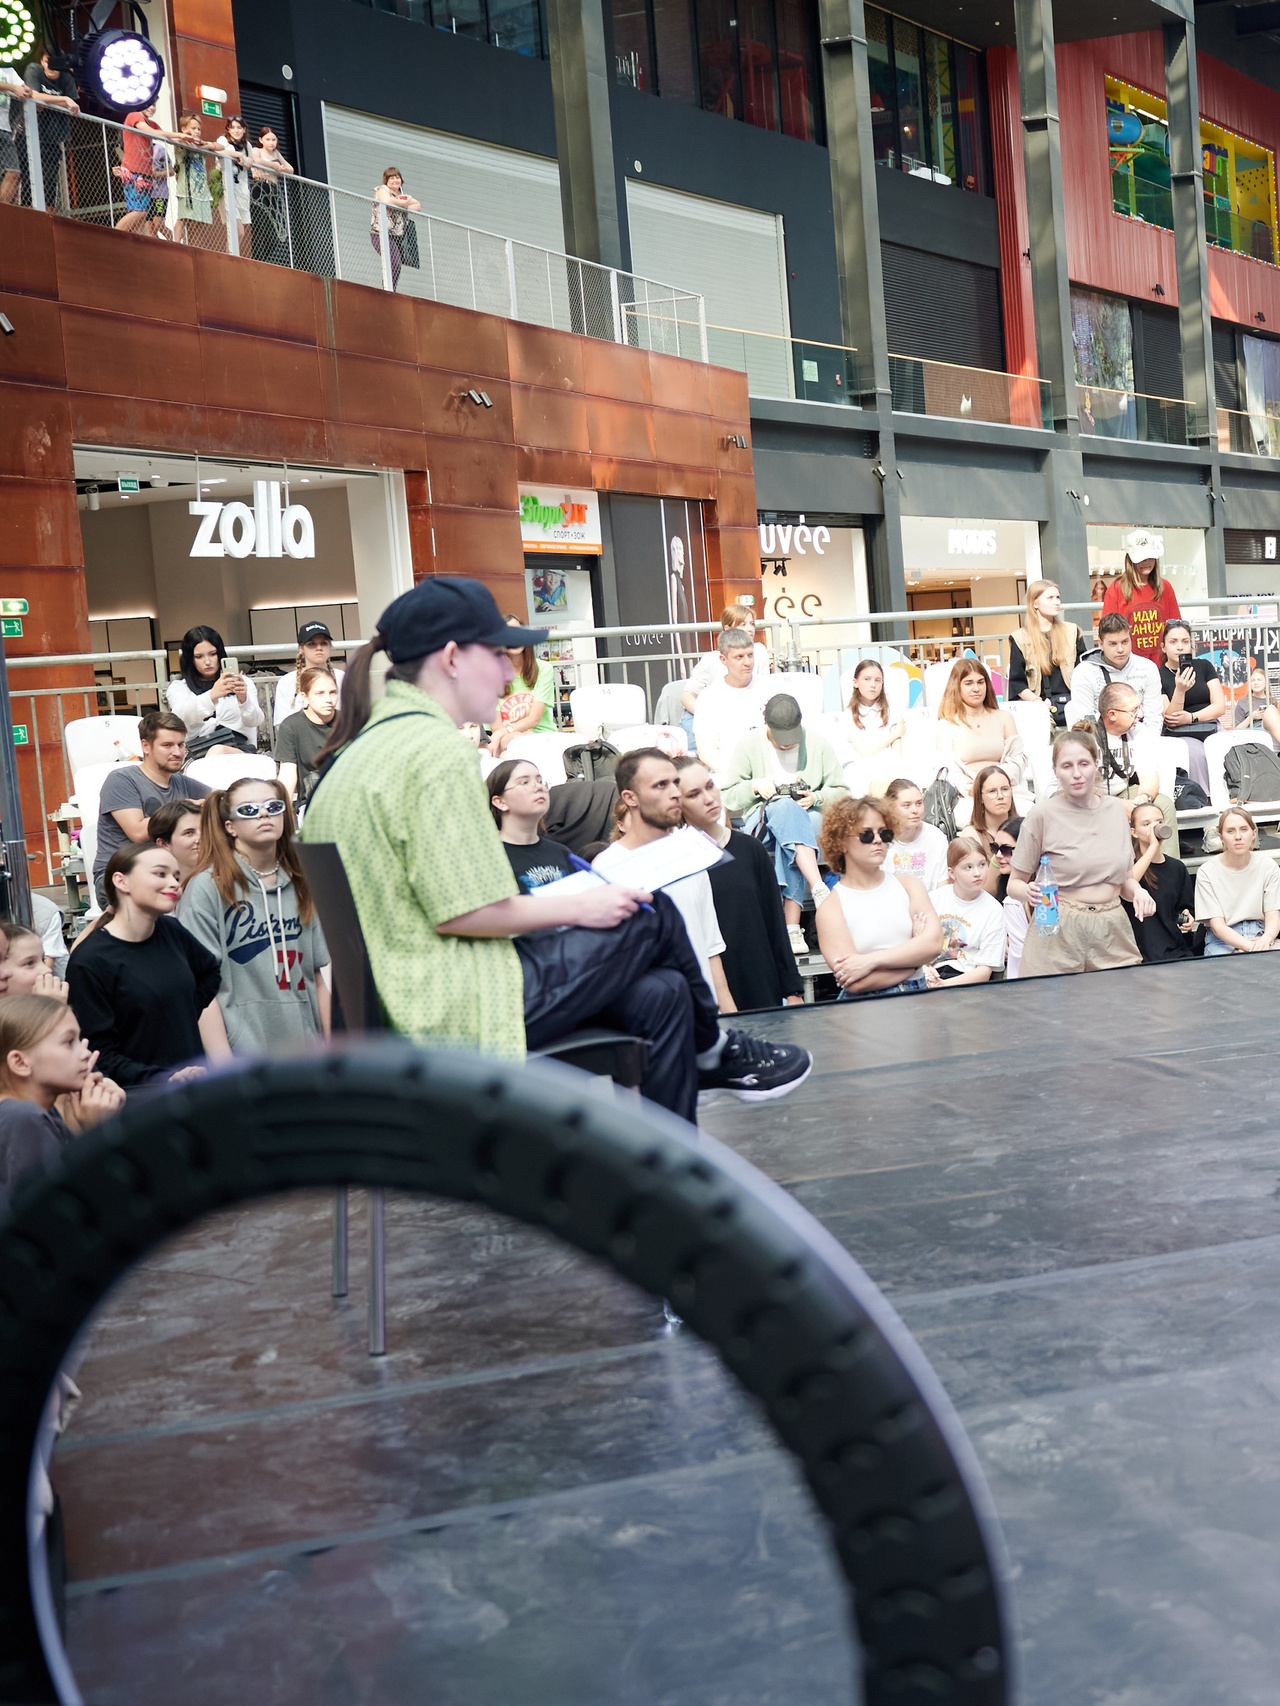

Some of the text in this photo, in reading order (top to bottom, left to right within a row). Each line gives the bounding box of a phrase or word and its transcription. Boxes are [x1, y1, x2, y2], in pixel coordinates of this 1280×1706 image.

[189, 480, 316, 559] zolla
[1133, 609, 1158, 623] ИДИ
[1130, 622, 1165, 636] АНЦУ
[1137, 636, 1159, 649] FEST
